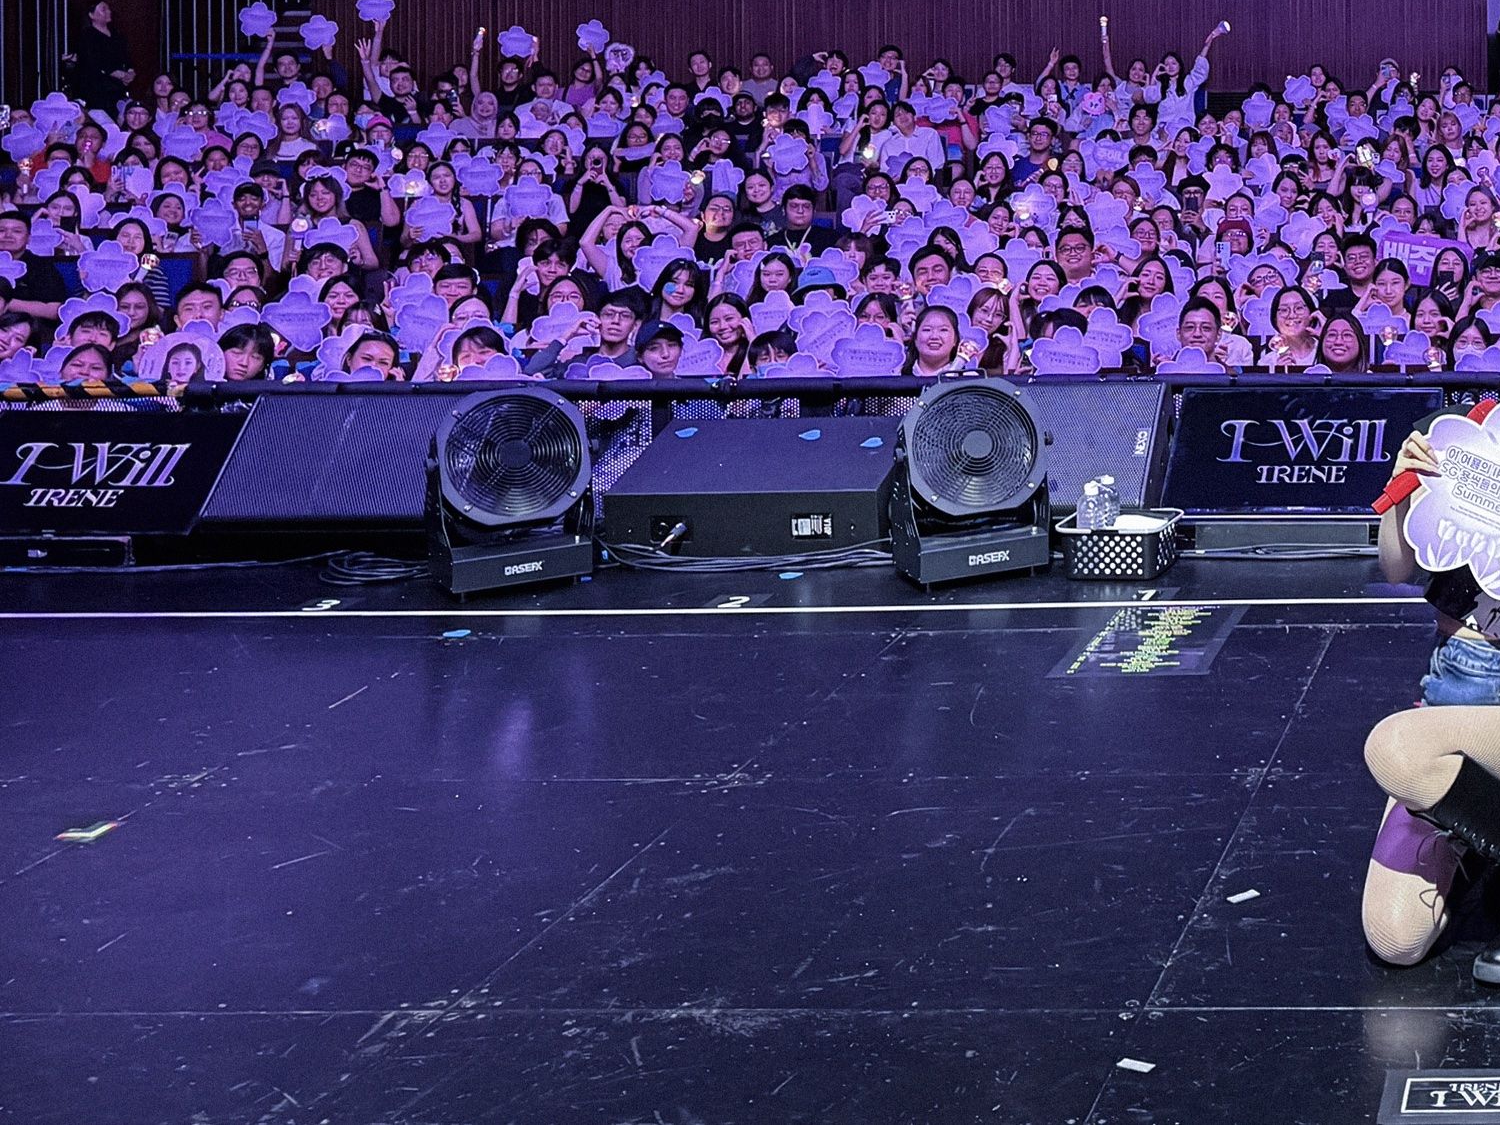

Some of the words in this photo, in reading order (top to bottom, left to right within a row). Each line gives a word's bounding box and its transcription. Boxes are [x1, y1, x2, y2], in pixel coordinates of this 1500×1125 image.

[1448, 448, 1460, 462] 이
[1256, 465, 1348, 484] IRENE
[1441, 462, 1458, 477] SG
[23, 488, 124, 507] IRENE
[302, 599, 341, 611] 3
[717, 595, 750, 608] 2
